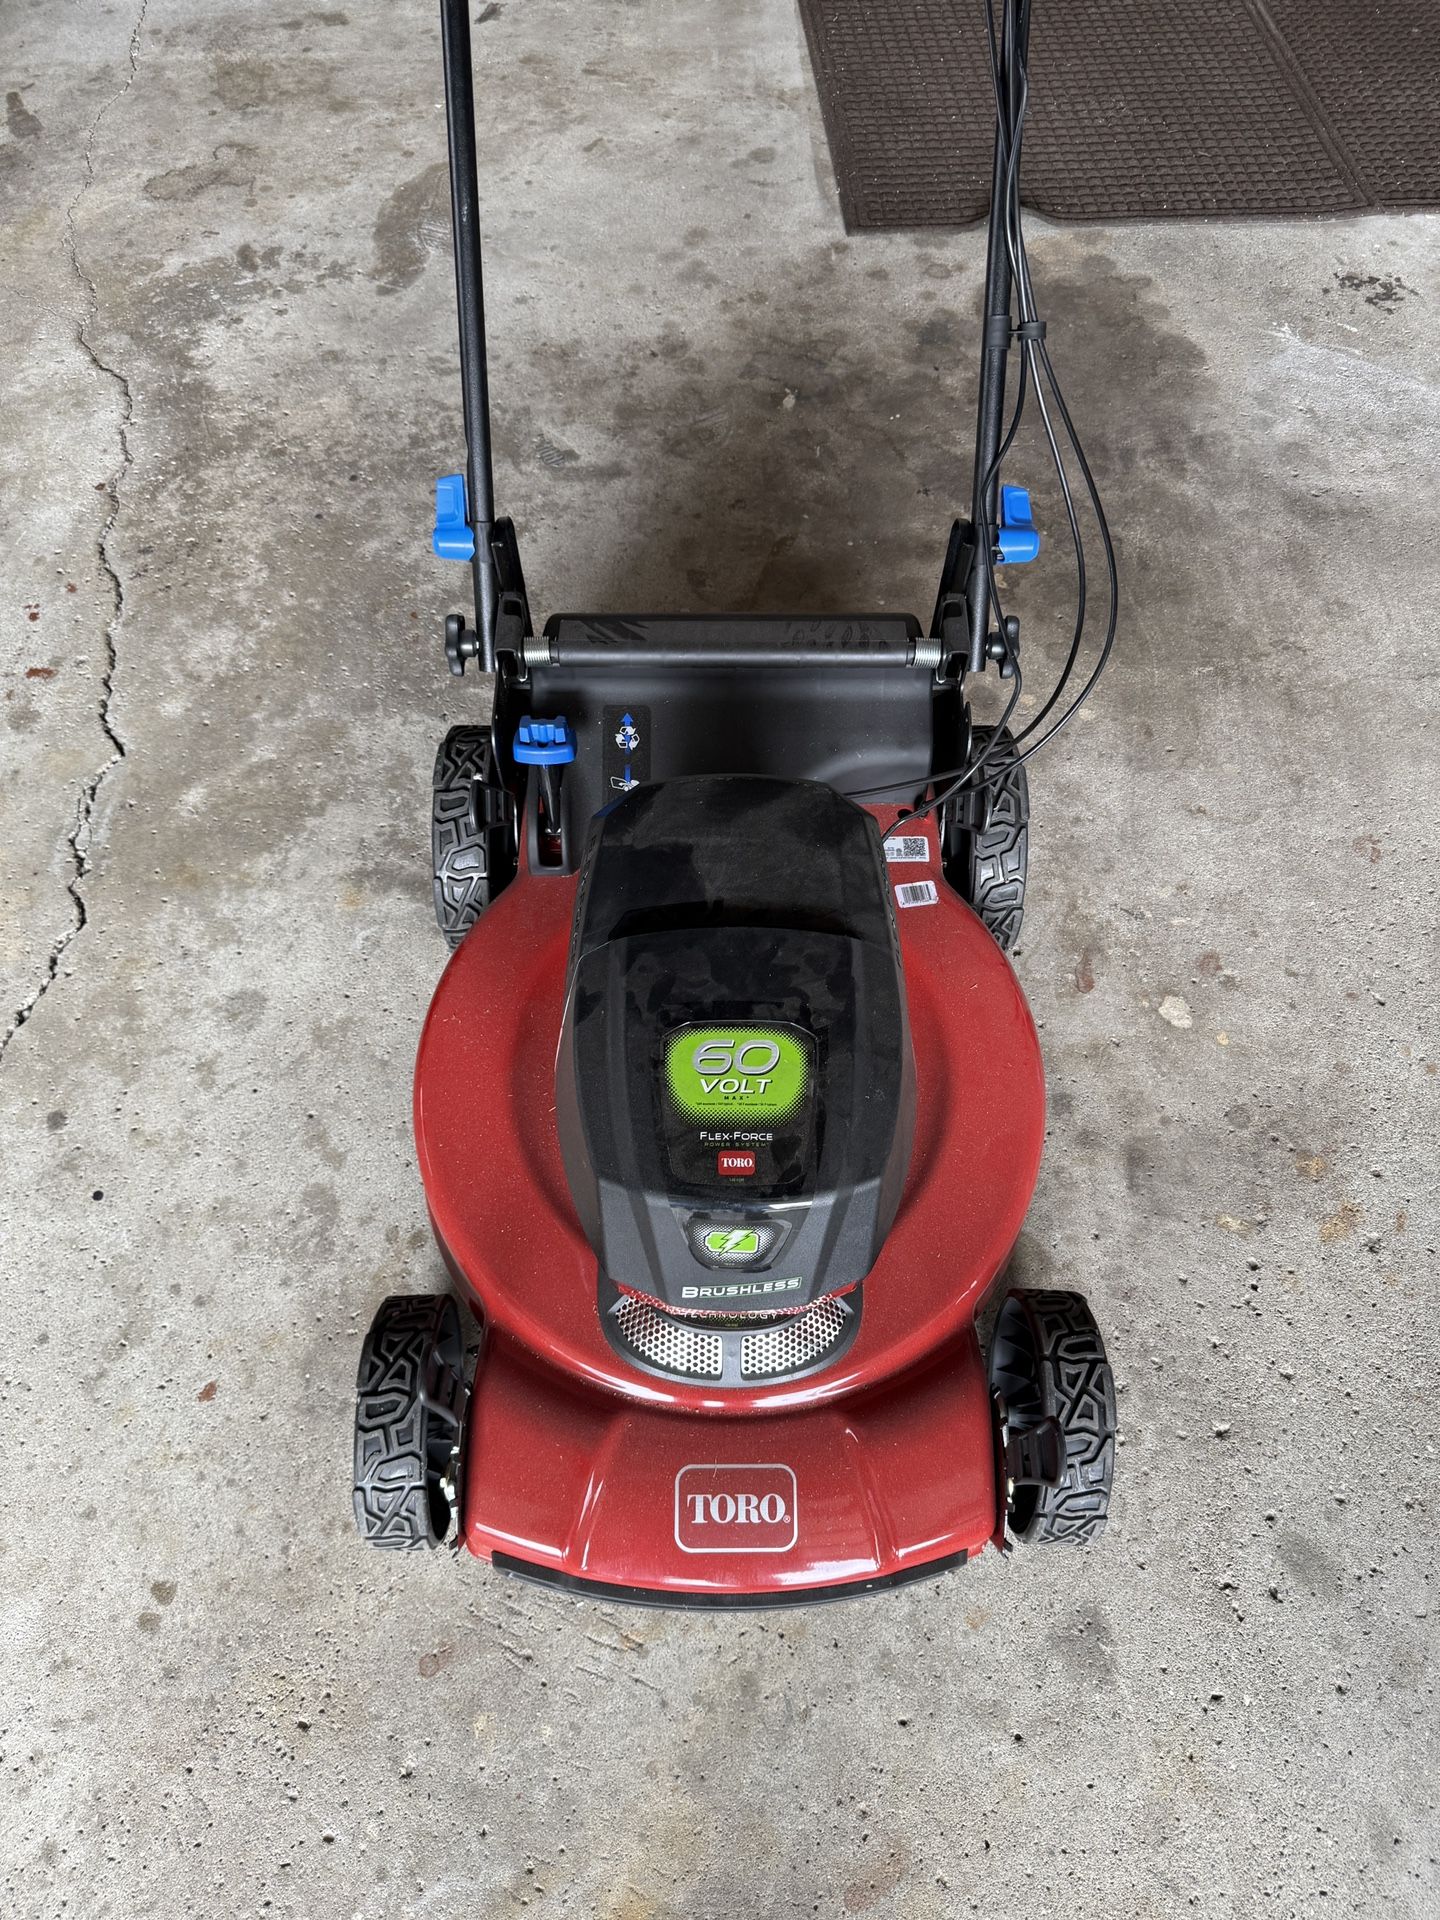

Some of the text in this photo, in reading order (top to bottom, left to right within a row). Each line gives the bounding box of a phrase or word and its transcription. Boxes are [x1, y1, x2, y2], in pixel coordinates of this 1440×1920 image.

[692, 1039, 780, 1075] 60
[700, 1078, 773, 1094] VOLT
[700, 1131, 773, 1141] FLEX-FORCE
[681, 1279, 800, 1299] BRUSHLESS
